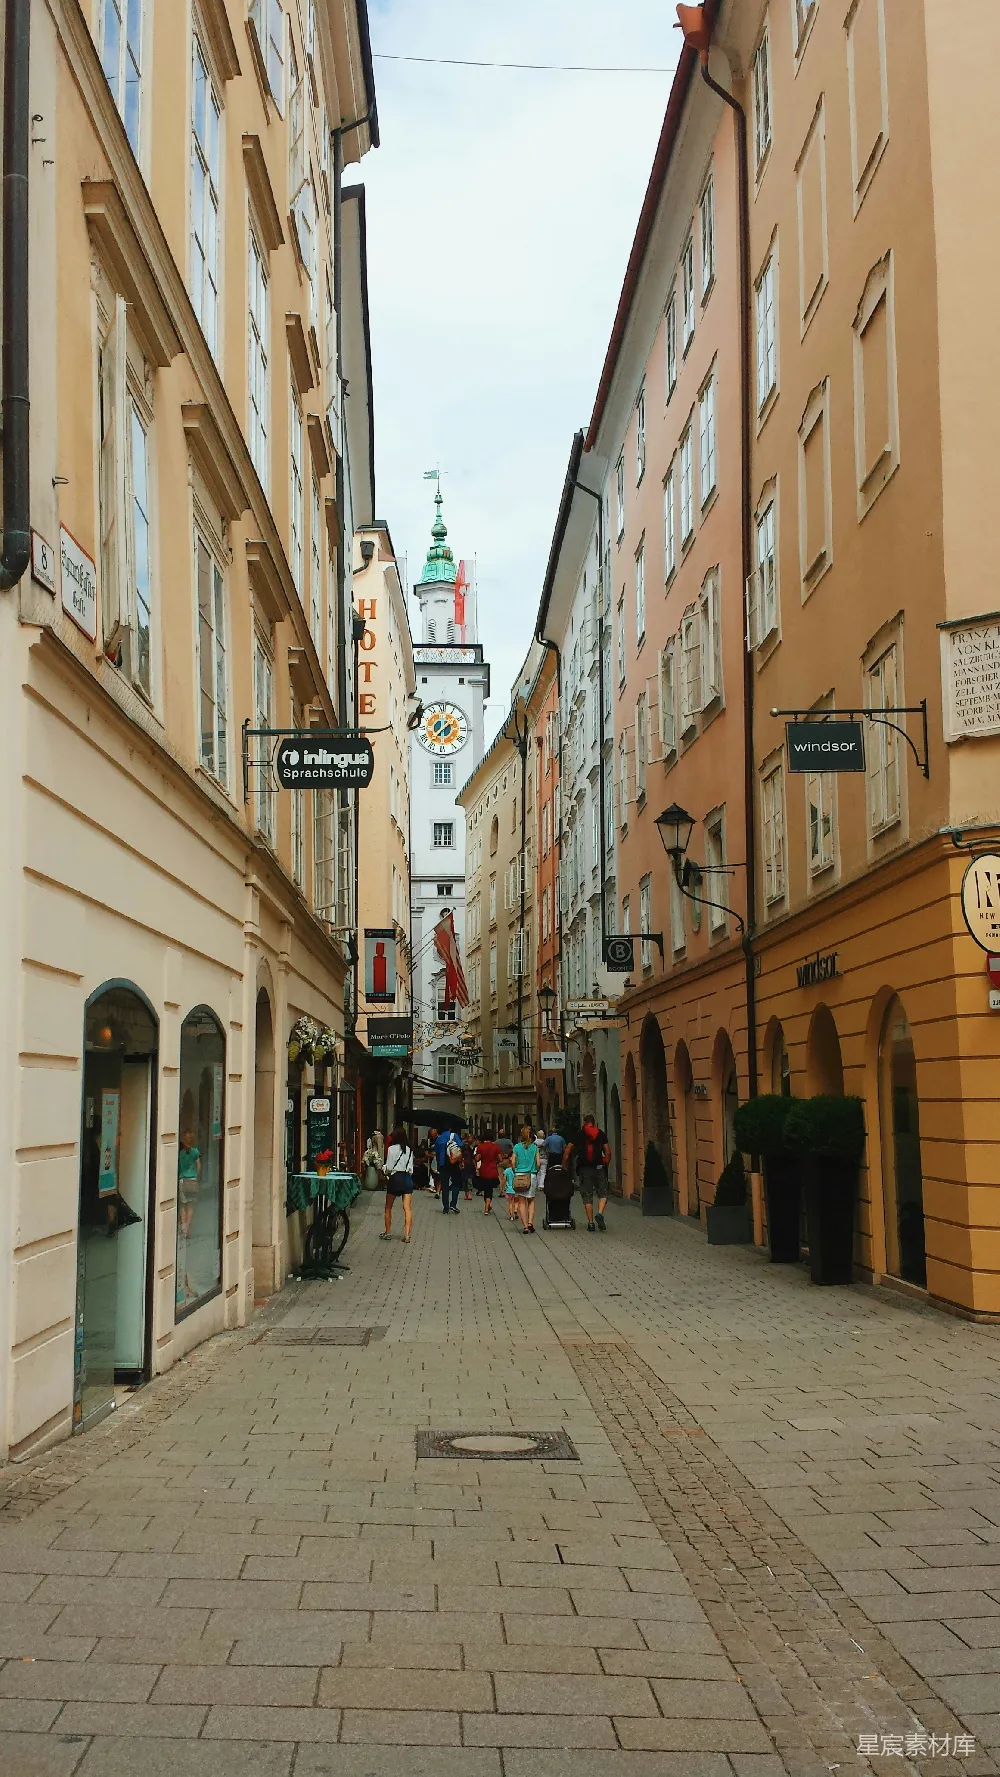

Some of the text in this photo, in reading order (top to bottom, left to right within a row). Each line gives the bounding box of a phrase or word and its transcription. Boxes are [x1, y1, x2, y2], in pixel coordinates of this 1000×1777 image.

[41, 544, 48, 571] 8
[957, 642, 981, 655] VON
[794, 741, 858, 752] windsor.
[303, 748, 369, 768] inlingua
[283, 768, 368, 779] Sprachschule
[979, 912, 996, 920] NEW
